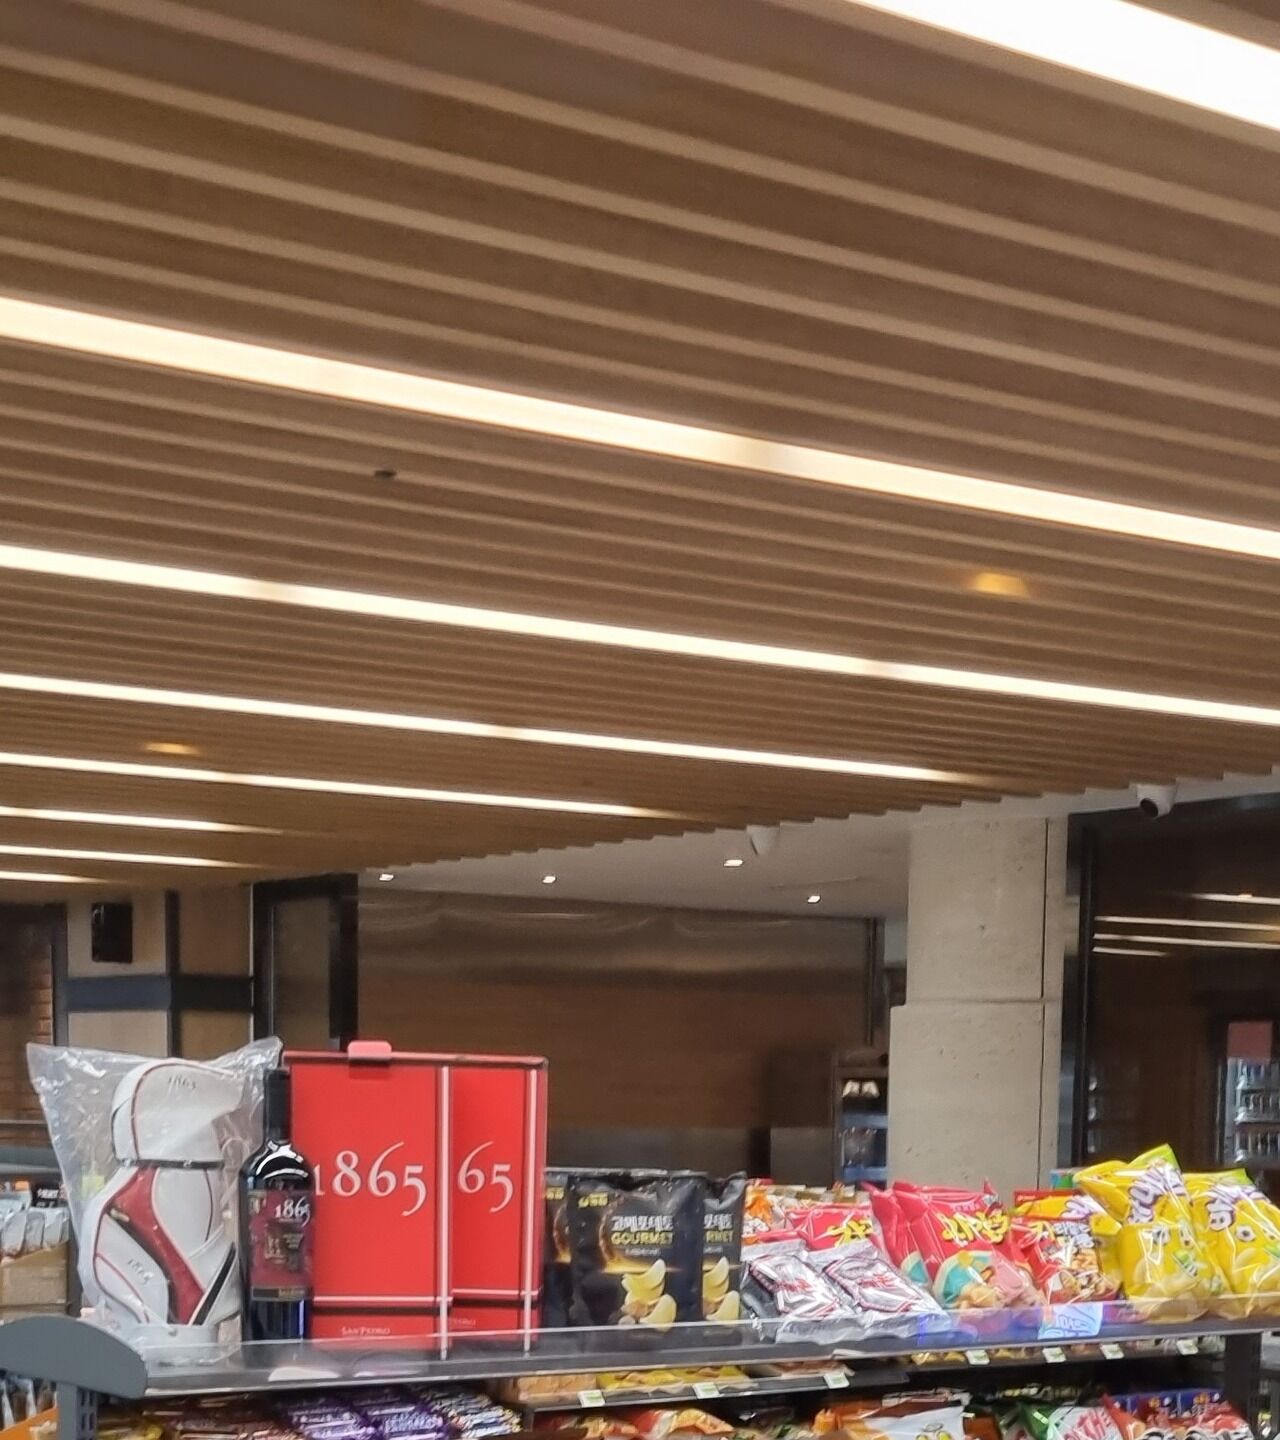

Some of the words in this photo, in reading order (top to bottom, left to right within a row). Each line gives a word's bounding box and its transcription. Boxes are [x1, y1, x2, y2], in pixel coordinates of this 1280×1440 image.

[314, 1140, 428, 1218] 1865
[274, 1195, 311, 1228] 1865
[610, 1230, 675, 1246] GOURMET
